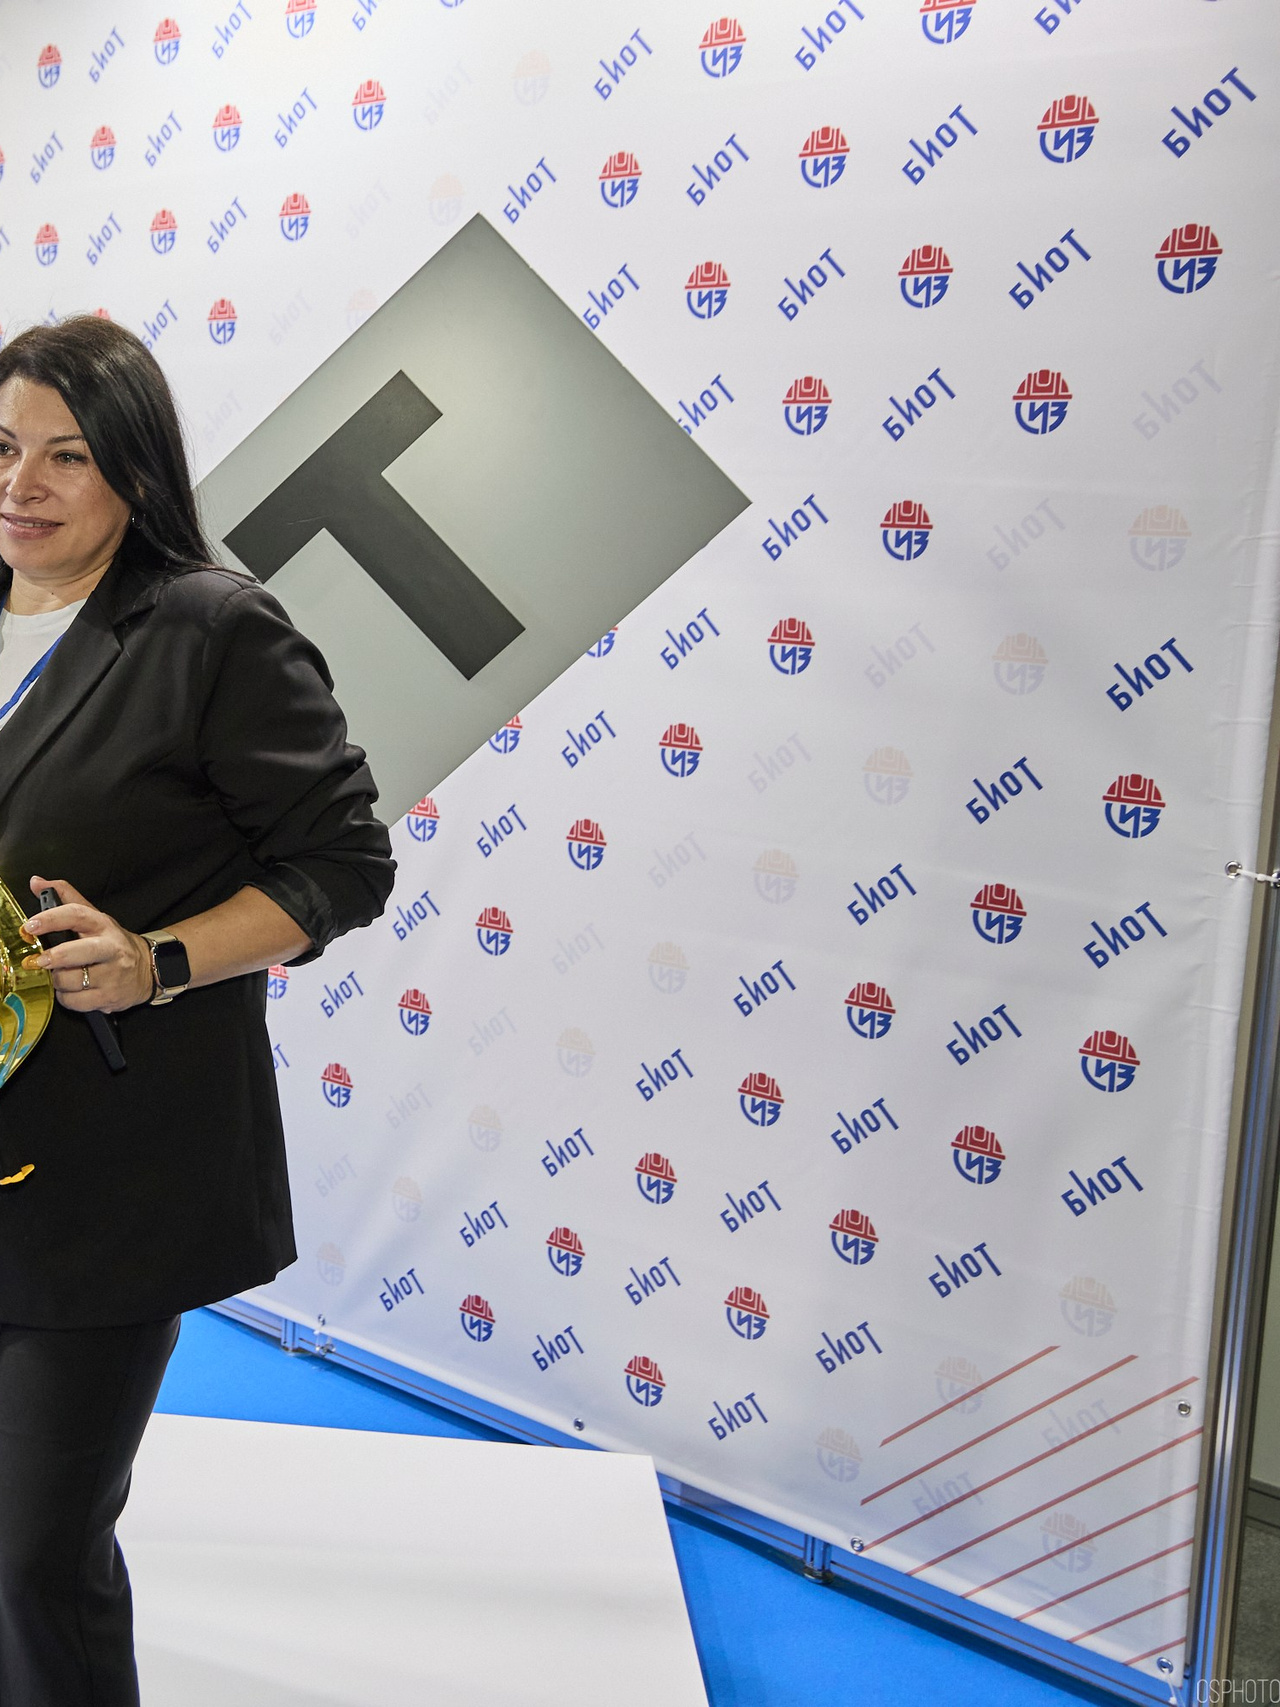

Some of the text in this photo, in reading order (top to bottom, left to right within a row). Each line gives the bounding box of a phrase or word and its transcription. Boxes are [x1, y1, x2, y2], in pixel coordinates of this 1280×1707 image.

[212, 0, 252, 59] БИОТ
[352, 0, 377, 32] БИ
[794, 0, 865, 72] БИОТ
[921, 7, 973, 46] СИЗ
[89, 26, 126, 82] БИОТ
[594, 30, 652, 100] БИОТ
[700, 45, 743, 79] СИЗ
[274, 86, 319, 148] БИОТ
[1161, 67, 1256, 158] БИОТ
[31, 131, 63, 183] БИОТ
[145, 110, 183, 167] БИОТ
[901, 105, 978, 185] БИОТ
[1038, 126, 1095, 164] СИЗ
[503, 158, 556, 224] БИОТ
[600, 178, 639, 209] СИЗ
[686, 134, 749, 206] БИОТ
[800, 155, 847, 189] СИЗ
[87, 212, 123, 265] БИОТ
[207, 195, 249, 253] БИОТ
[777, 248, 845, 321] БИОТ
[899, 275, 950, 309] СИЗ
[1009, 228, 1091, 310] БИОТ
[1157, 257, 1218, 295] СИЗ
[582, 263, 640, 331] БИОТ
[686, 289, 728, 320] СИЗ
[783, 405, 829, 436] СИЗ
[882, 368, 956, 442] БИОТ
[1014, 401, 1068, 435] СИЗ
[761, 494, 828, 561] БИОТ
[882, 530, 930, 561] СИЗ
[586, 632, 615, 657] ИЗ
[660, 608, 720, 670] БИОТ
[768, 645, 812, 676] СИЗ
[1106, 638, 1193, 711] БИОТ
[561, 711, 616, 768] БИОТ
[660, 748, 700, 778] СИЗ
[966, 757, 1042, 824] БИОТ
[476, 804, 527, 858] БИОТ
[1104, 803, 1161, 839] СИЗ
[567, 842, 604, 871] СИЗ
[392, 891, 440, 941] БИОТ
[847, 863, 916, 926] БИОТ
[477, 929, 511, 956] СИЗ
[972, 910, 1023, 944] СИЗ
[1083, 901, 1167, 968] БИОТ
[266, 977, 288, 999] ИЗ
[320, 970, 363, 1018] БИОТ
[733, 960, 795, 1017] БИОТ
[846, 1006, 892, 1039] СИЗ
[946, 1004, 1022, 1065] БИОТ
[635, 1048, 693, 1101] БИОТ
[1080, 1056, 1135, 1093] СИЗ
[739, 1095, 781, 1127] СИЗ
[830, 1097, 898, 1154] БИОТ
[541, 1127, 594, 1177] БИОТ
[952, 1149, 1001, 1185] СИЗ
[636, 1174, 675, 1205] СИЗ
[720, 1180, 781, 1232] БИОТ
[1061, 1156, 1143, 1216] БИОТ
[459, 1201, 508, 1247] БИОТ
[547, 1247, 582, 1277] СИЗ
[831, 1232, 875, 1265] СИЗ
[928, 1242, 1001, 1298] БИОТ
[379, 1268, 424, 1311] БИОТ
[624, 1257, 680, 1305] БИОТ
[460, 1314, 493, 1342] СИЗ
[726, 1307, 767, 1339] СИЗ
[816, 1321, 882, 1373] БИОТ
[531, 1326, 584, 1372] БИОТ
[625, 1375, 663, 1407] СИЗ
[708, 1392, 767, 1440] БИОТ
